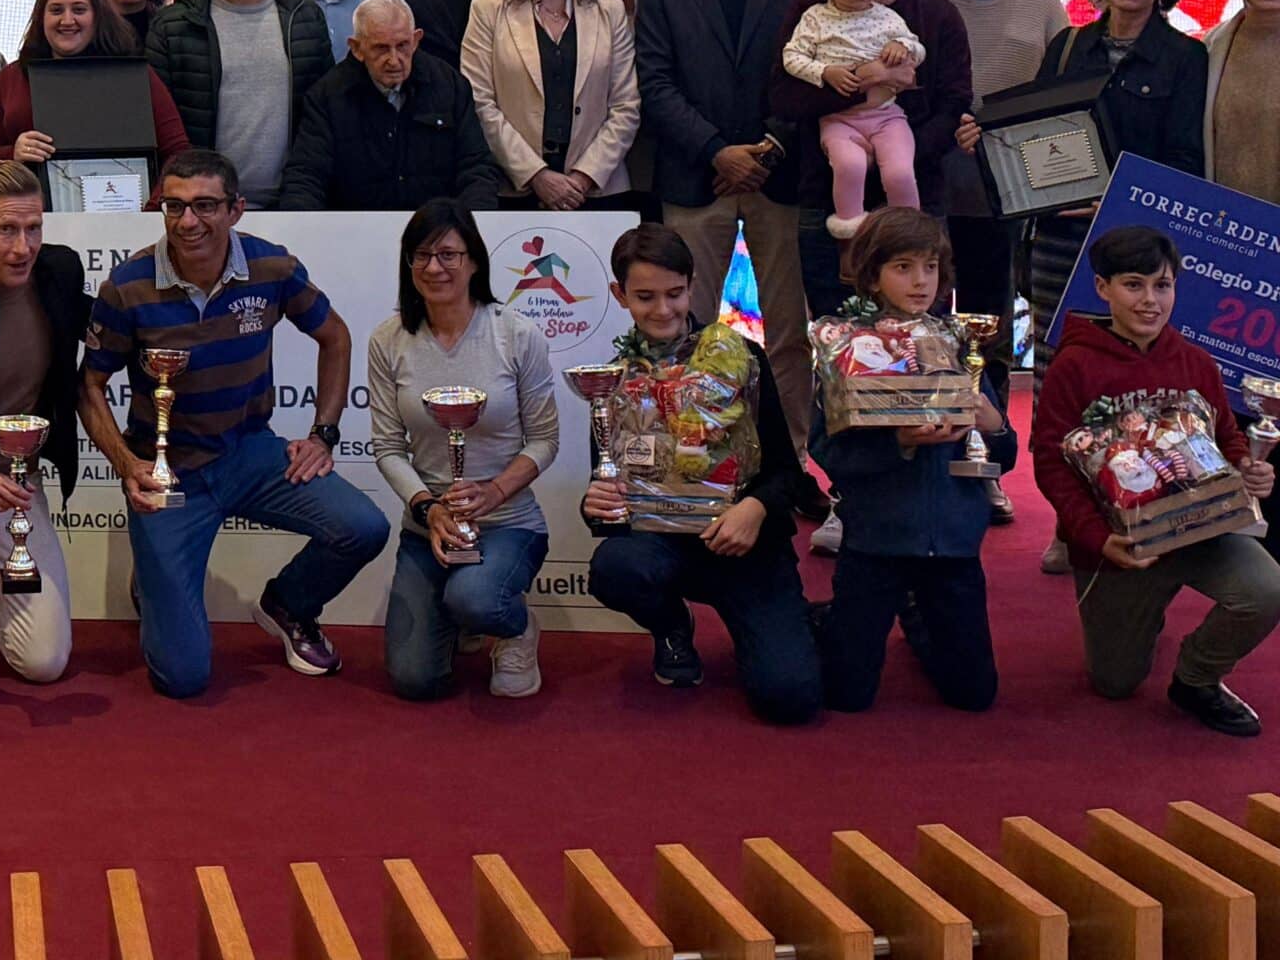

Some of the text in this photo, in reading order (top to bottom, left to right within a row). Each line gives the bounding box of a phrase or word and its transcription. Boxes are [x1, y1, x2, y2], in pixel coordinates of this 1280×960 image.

[1168, 220, 1259, 258] centro comercial
[1181, 255, 1252, 290] Colegio
[239, 320, 263, 334] ROCKS
[545, 319, 591, 338] Stop
[1180, 325, 1196, 339] En
[1198, 334, 1246, 357] material
